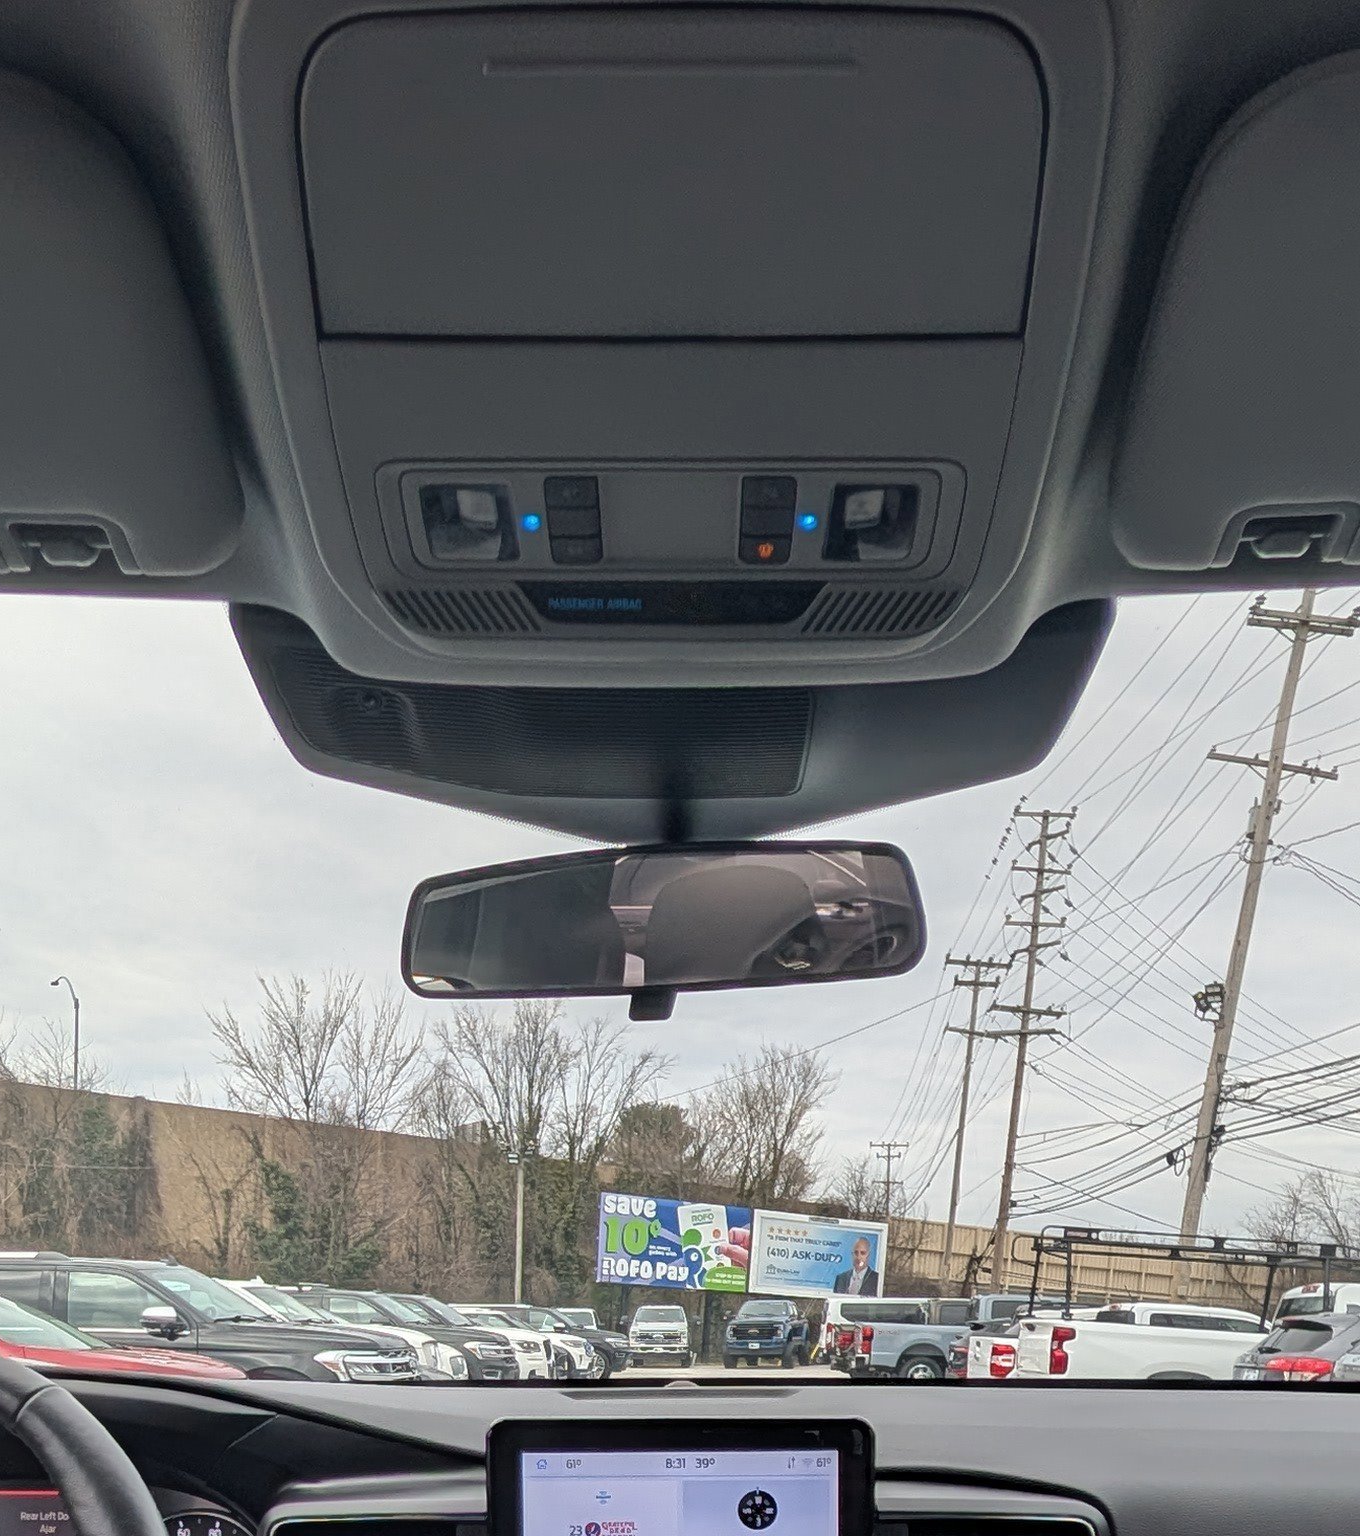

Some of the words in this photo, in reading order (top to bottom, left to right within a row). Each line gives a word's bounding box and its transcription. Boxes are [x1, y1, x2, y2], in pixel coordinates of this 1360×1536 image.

[767, 1246, 789, 1259] (410)
[602, 1257, 653, 1279] ROFO
[656, 1262, 689, 1282] Pay
[665, 1457, 687, 1469] 8:31
[20, 1511, 39, 1521] Rear
[40, 1511, 56, 1521] Left
[39, 1524, 57, 1535] Ajar
[569, 1525, 583, 1536] 23
